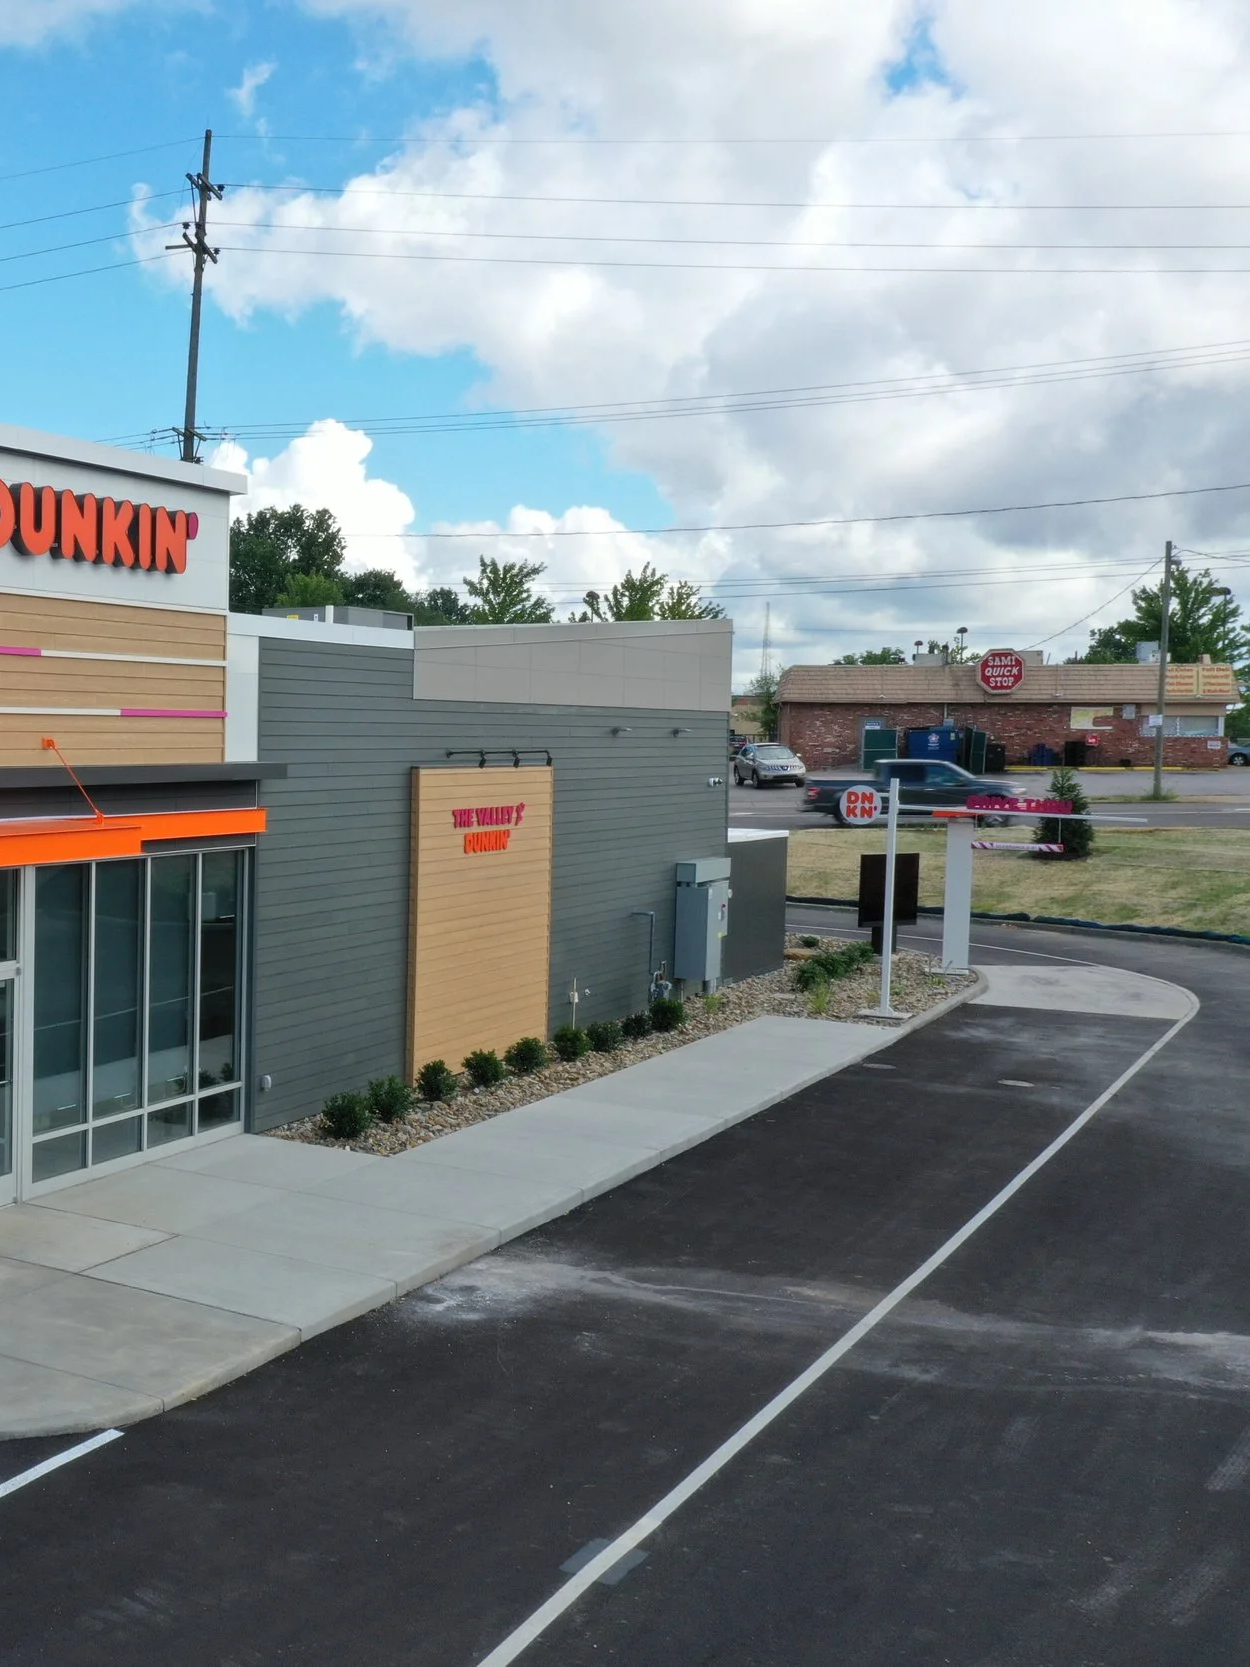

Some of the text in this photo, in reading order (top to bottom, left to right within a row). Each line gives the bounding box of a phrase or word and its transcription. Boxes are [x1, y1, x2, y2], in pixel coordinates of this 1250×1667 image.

[987, 655, 1016, 666] SAMI
[984, 666, 1020, 676] QUICK
[989, 677, 1015, 687] STOP
[846, 791, 874, 805] DN
[846, 805, 878, 818] KN'
[452, 808, 475, 828] THE
